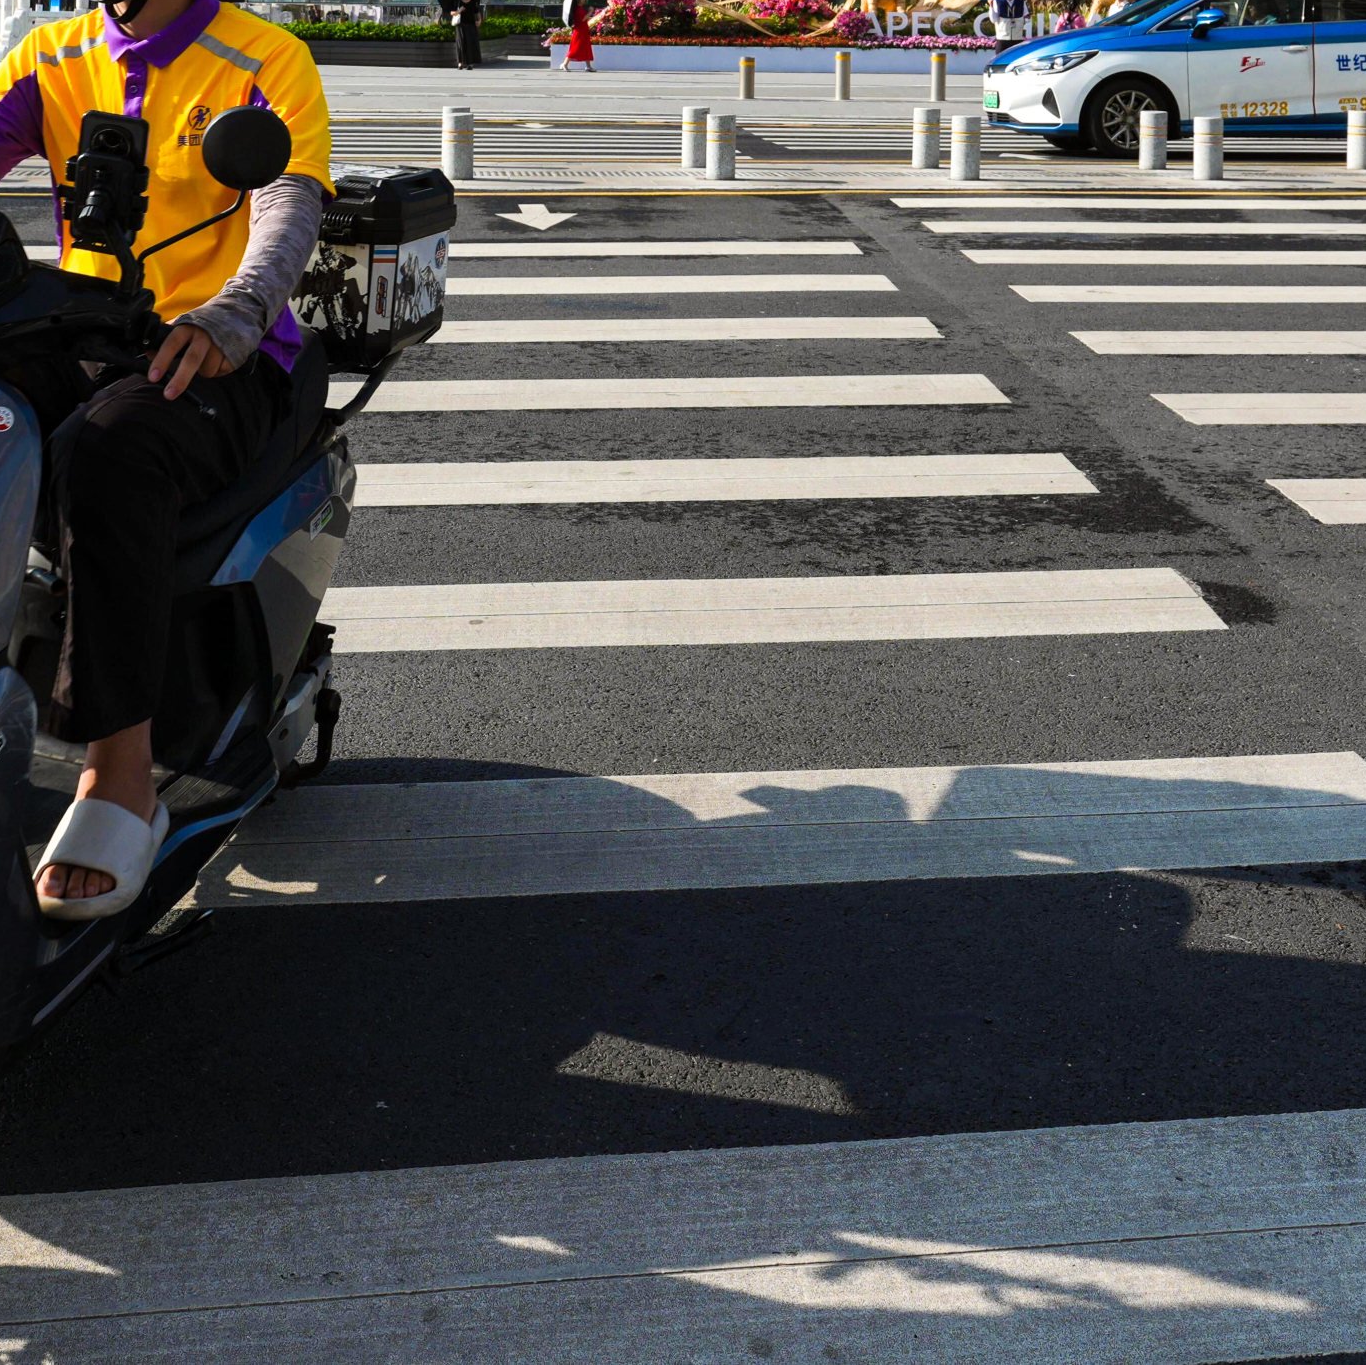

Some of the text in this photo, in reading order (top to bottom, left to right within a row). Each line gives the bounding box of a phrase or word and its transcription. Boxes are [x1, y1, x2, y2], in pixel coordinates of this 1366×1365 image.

[865, 11, 962, 38] APEC
[1241, 101, 1289, 117] 12328
[178, 134, 203, 147] 美团
